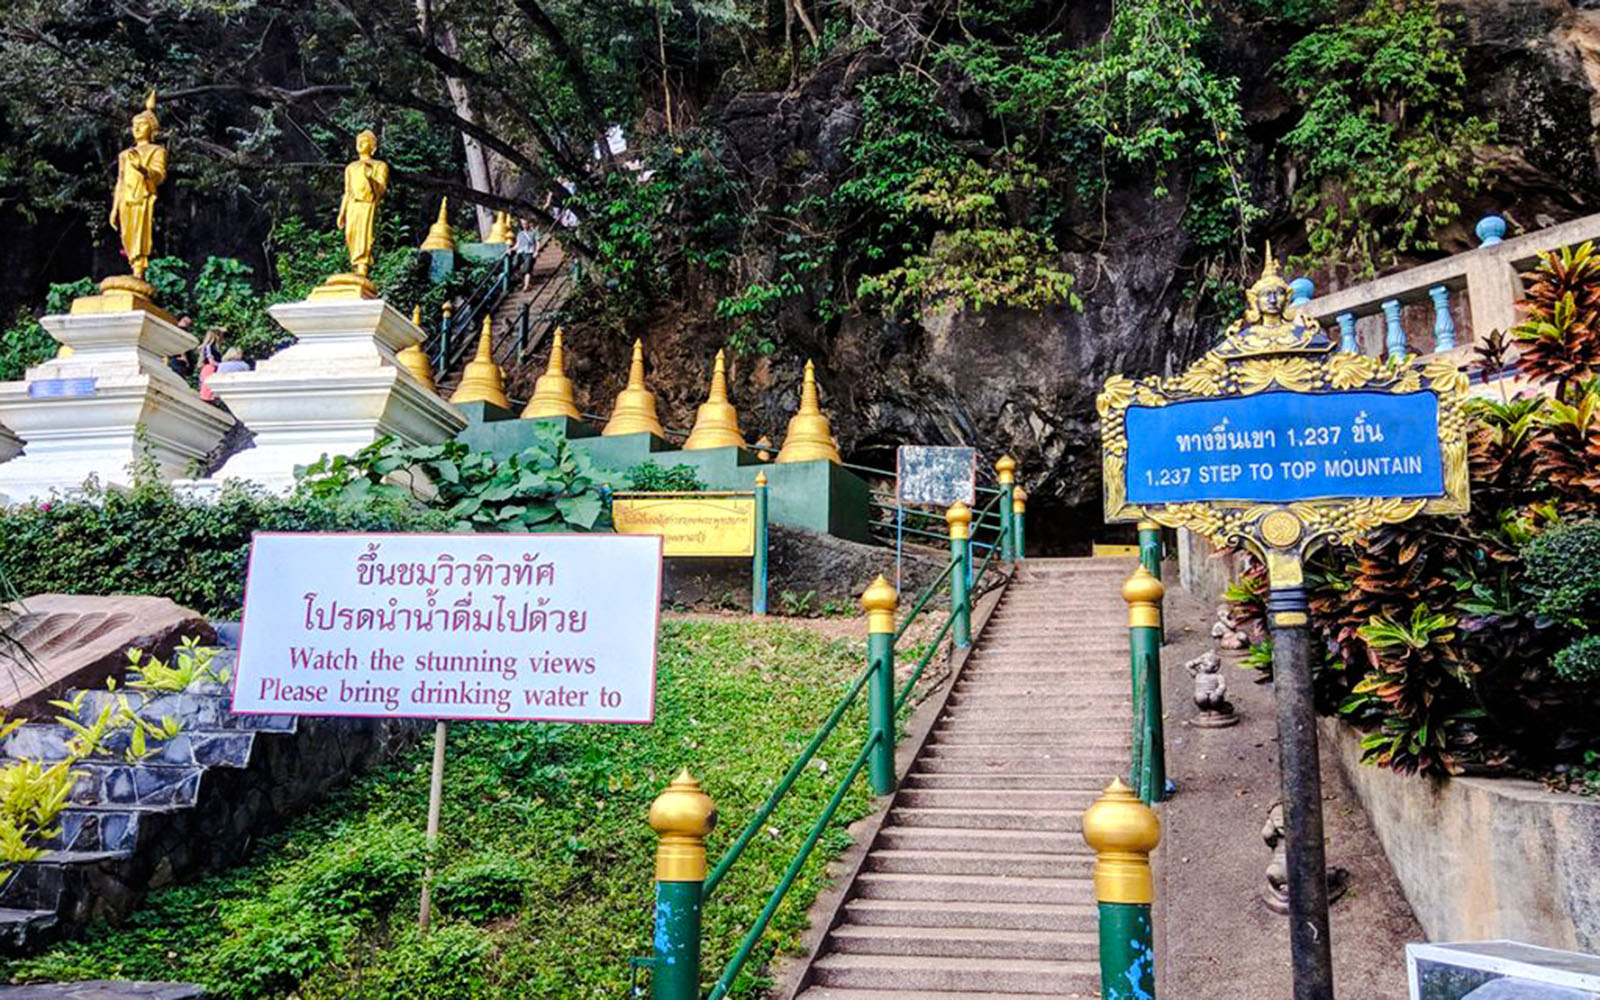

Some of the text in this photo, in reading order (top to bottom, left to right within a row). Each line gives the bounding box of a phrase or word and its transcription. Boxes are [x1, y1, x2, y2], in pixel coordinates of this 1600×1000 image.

[1352, 411, 1383, 442] ขั้น
[1200, 465, 1241, 482] STEP
[1250, 463, 1272, 479] TO
[1281, 462, 1315, 479] TOP
[1325, 456, 1421, 477] MOUNTAIN
[357, 543, 554, 585] ขึ้นชมวิวทิวทัศ
[304, 589, 586, 632] โปรดนำน้ำดื่มไปด้วย
[290, 647, 595, 680] Watch the stunning views
[259, 678, 621, 713] Please bring drinking water to
